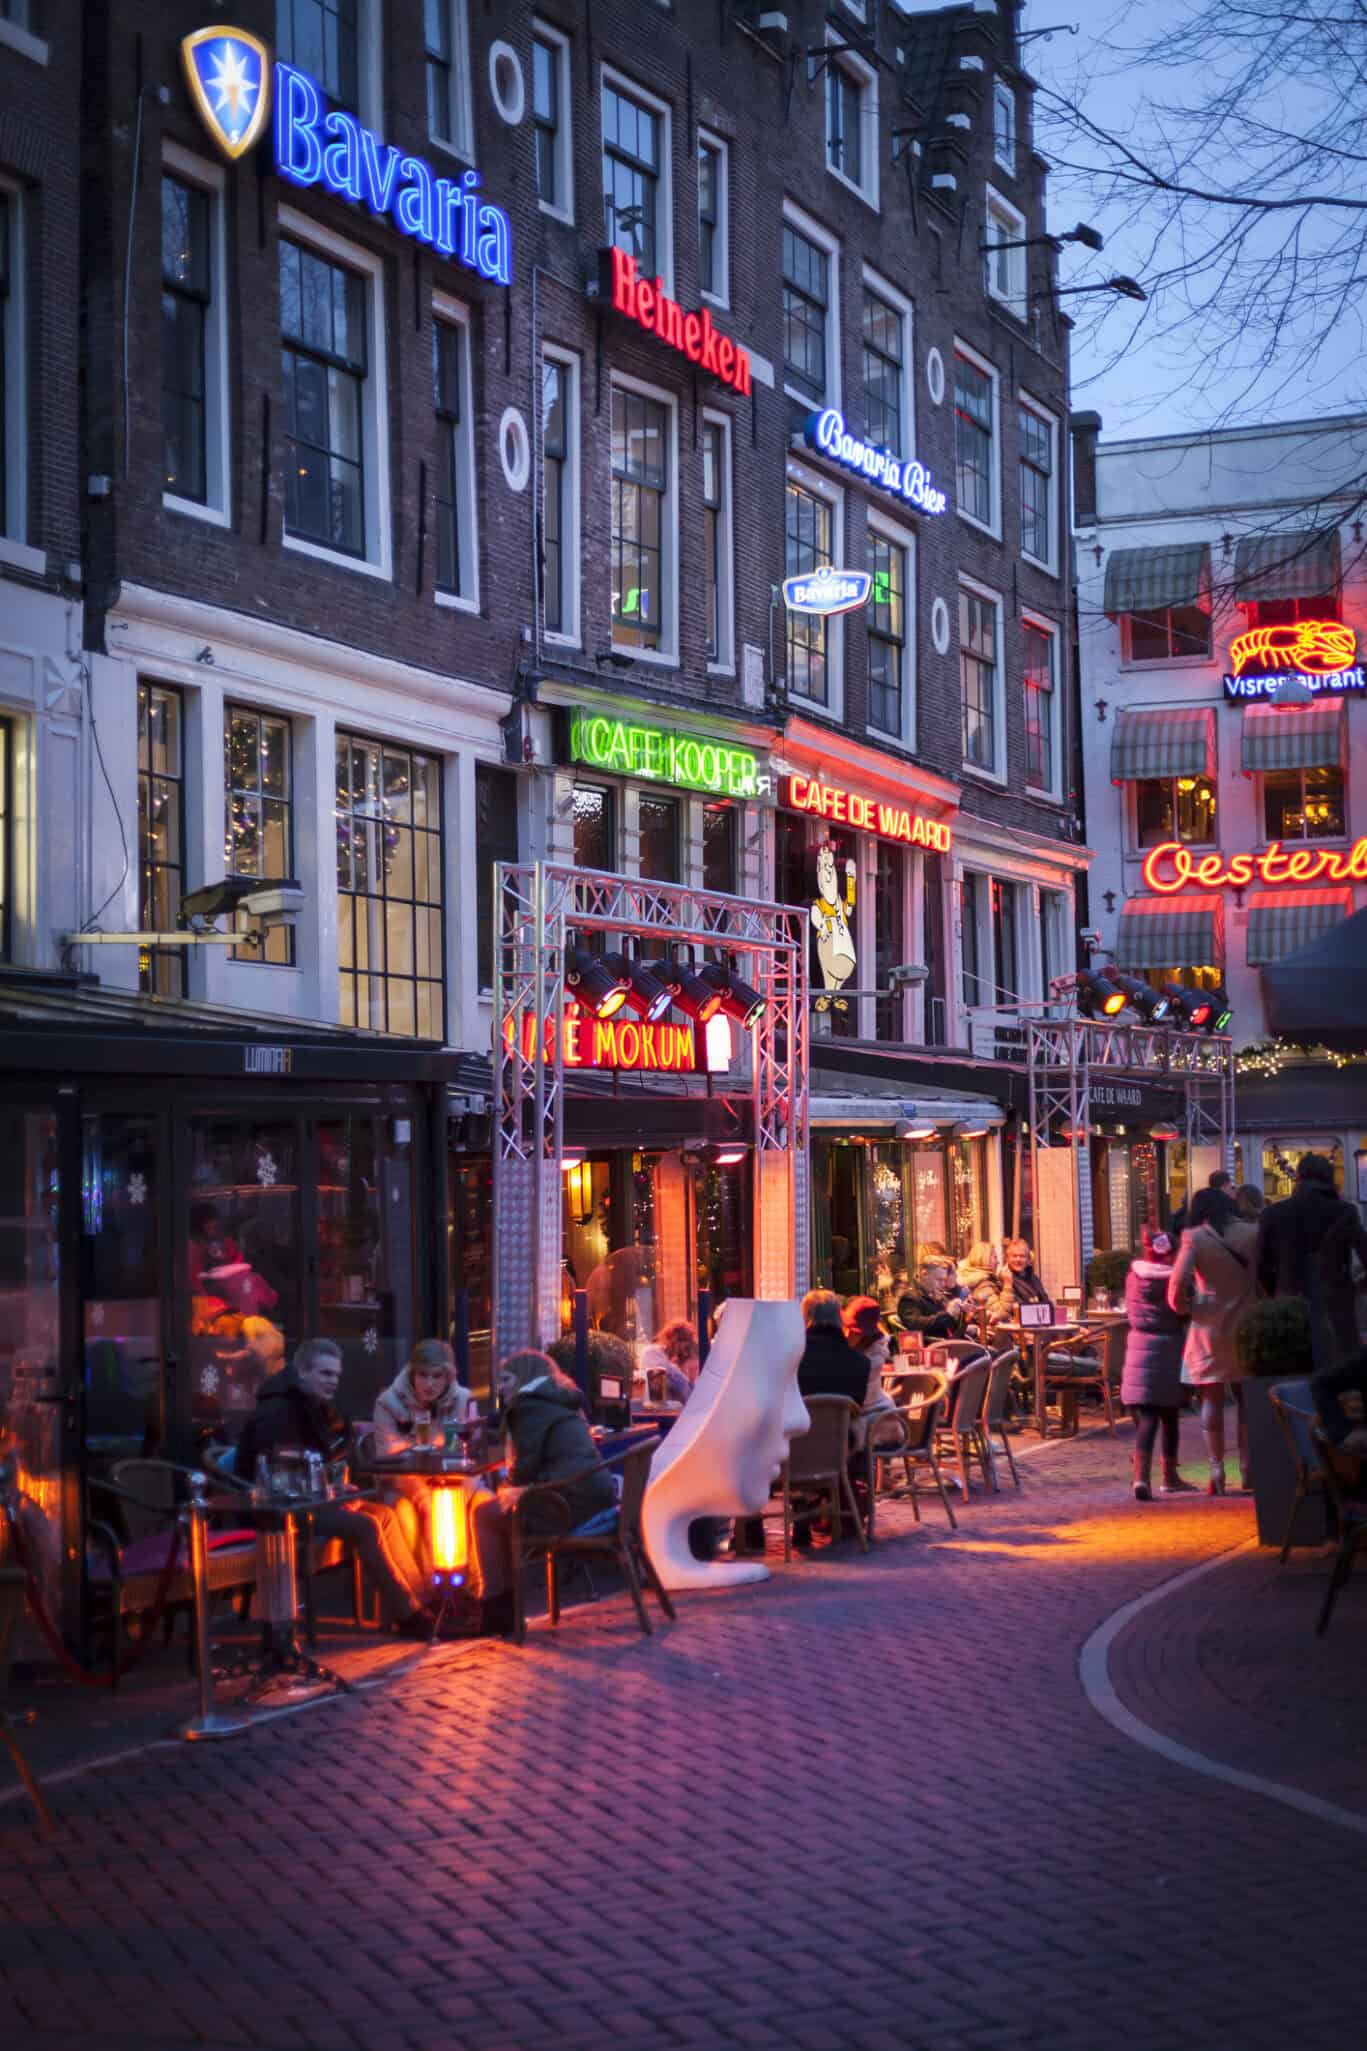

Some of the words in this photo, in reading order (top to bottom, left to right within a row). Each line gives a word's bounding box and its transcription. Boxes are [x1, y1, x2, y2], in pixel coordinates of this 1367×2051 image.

[275, 60, 513, 285] Bavaria
[612, 246, 752, 397] Heineken
[818, 409, 901, 490] Bavaria
[903, 461, 946, 514] Bier
[1224, 667, 1365, 697] Visreaurant
[591, 717, 663, 775] CAFE
[668, 735, 756, 797] KOOPER
[789, 774, 847, 821] CAFE
[849, 794, 876, 830] DE
[879, 803, 951, 853] WAARD
[596, 1021, 696, 1069] MOKUM
